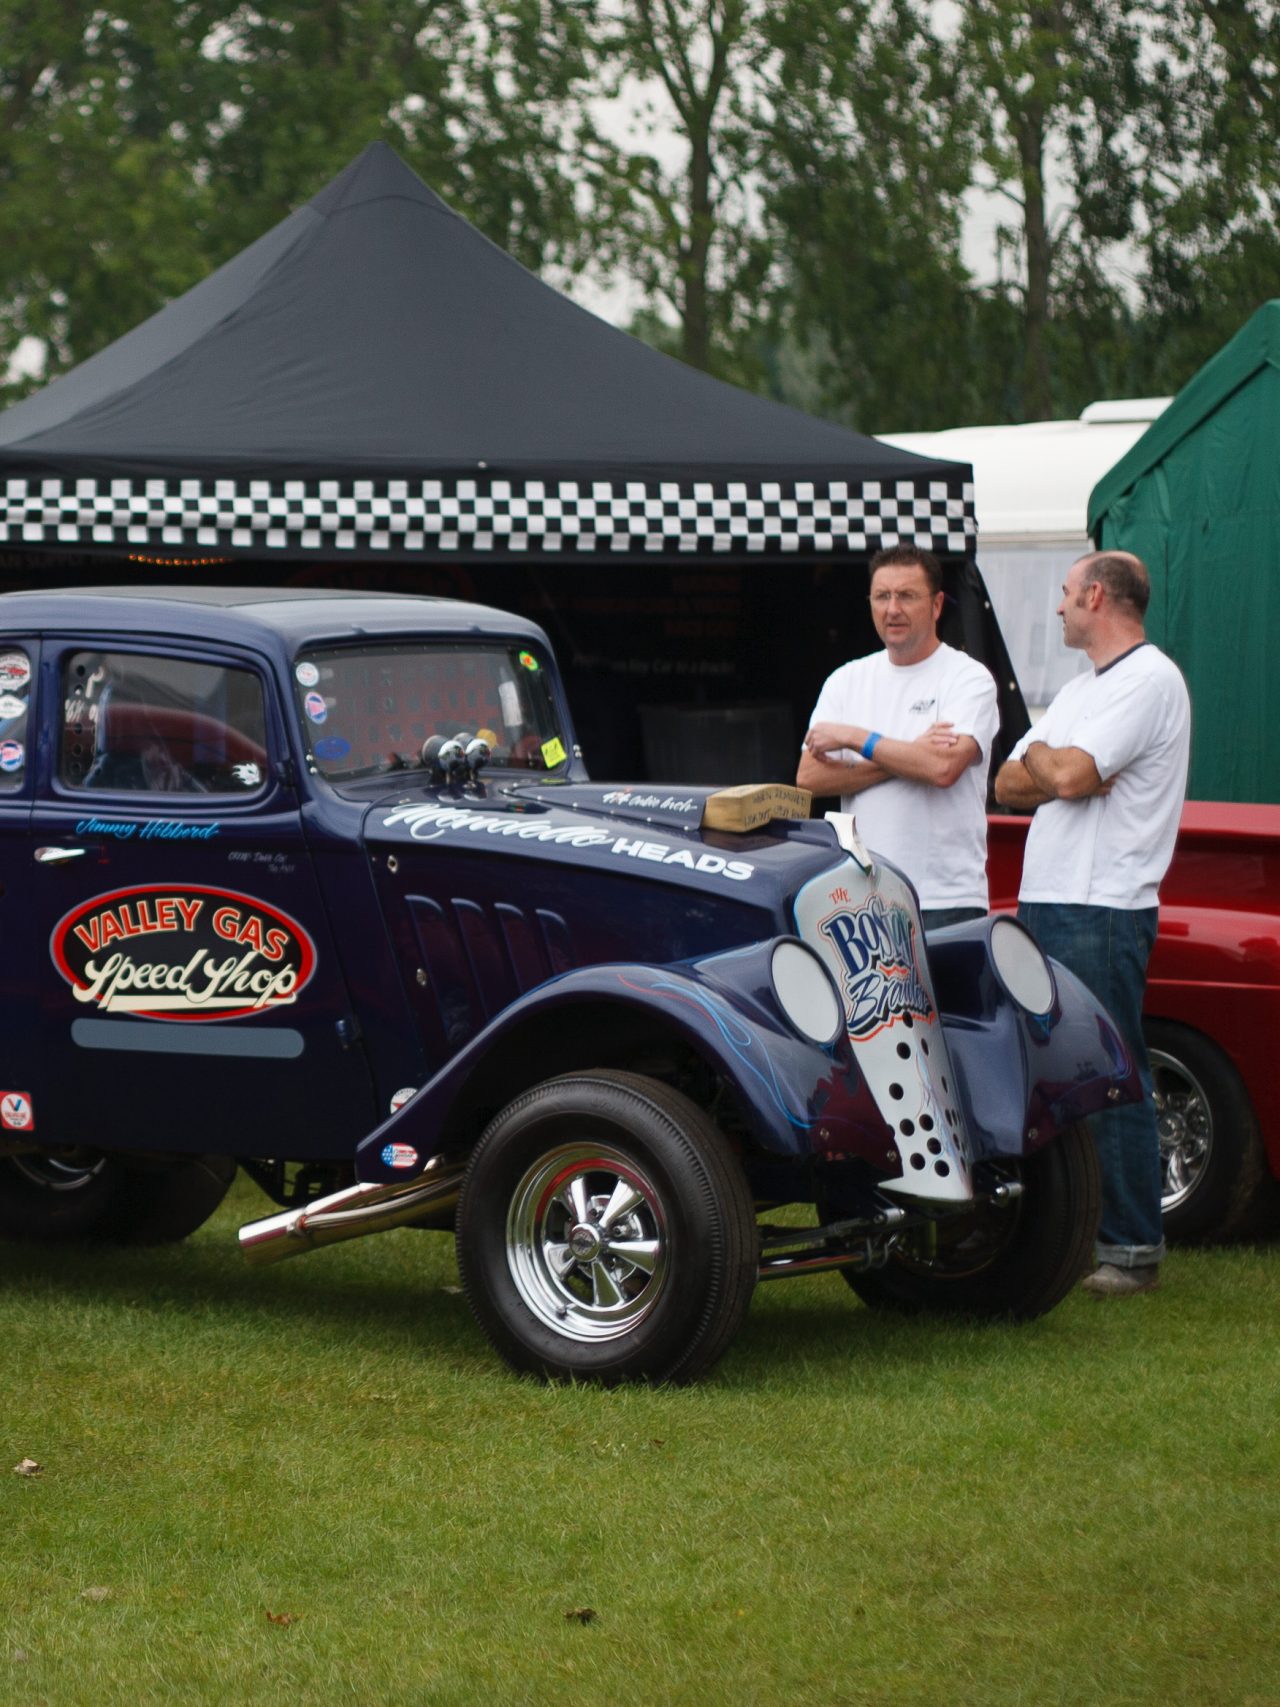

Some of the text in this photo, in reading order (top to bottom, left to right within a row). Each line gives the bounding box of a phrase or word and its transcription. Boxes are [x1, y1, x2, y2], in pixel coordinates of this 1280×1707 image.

[75, 816, 137, 840] Jimmy
[382, 801, 755, 882] Mondello HEADS
[828, 887, 851, 905] THE
[73, 897, 289, 962] VALLEY GAS
[72, 949, 298, 1010] Speed Shop
